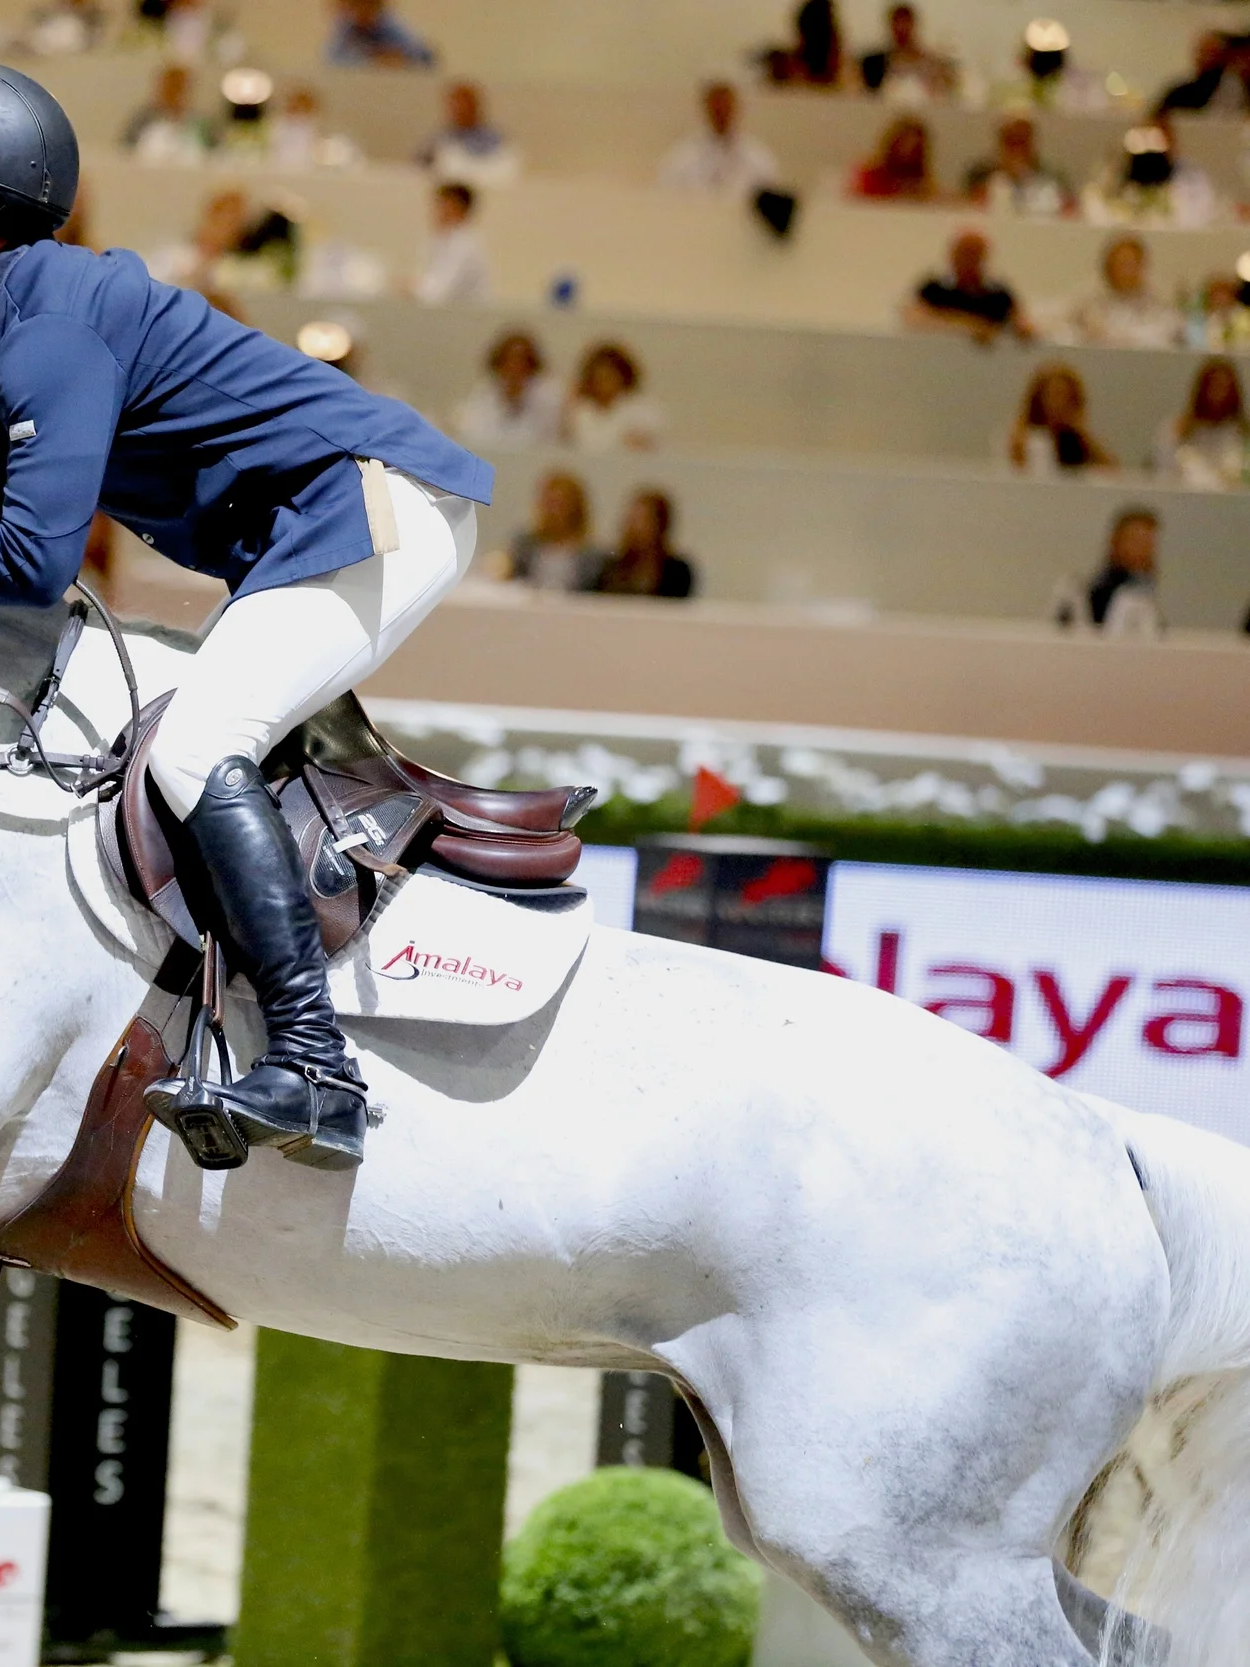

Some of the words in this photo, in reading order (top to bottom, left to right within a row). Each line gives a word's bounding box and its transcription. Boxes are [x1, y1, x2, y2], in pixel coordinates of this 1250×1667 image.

[381, 940, 523, 991] Amalaya
[822, 931, 1243, 1081] laya
[93, 1290, 135, 1506] ELES
